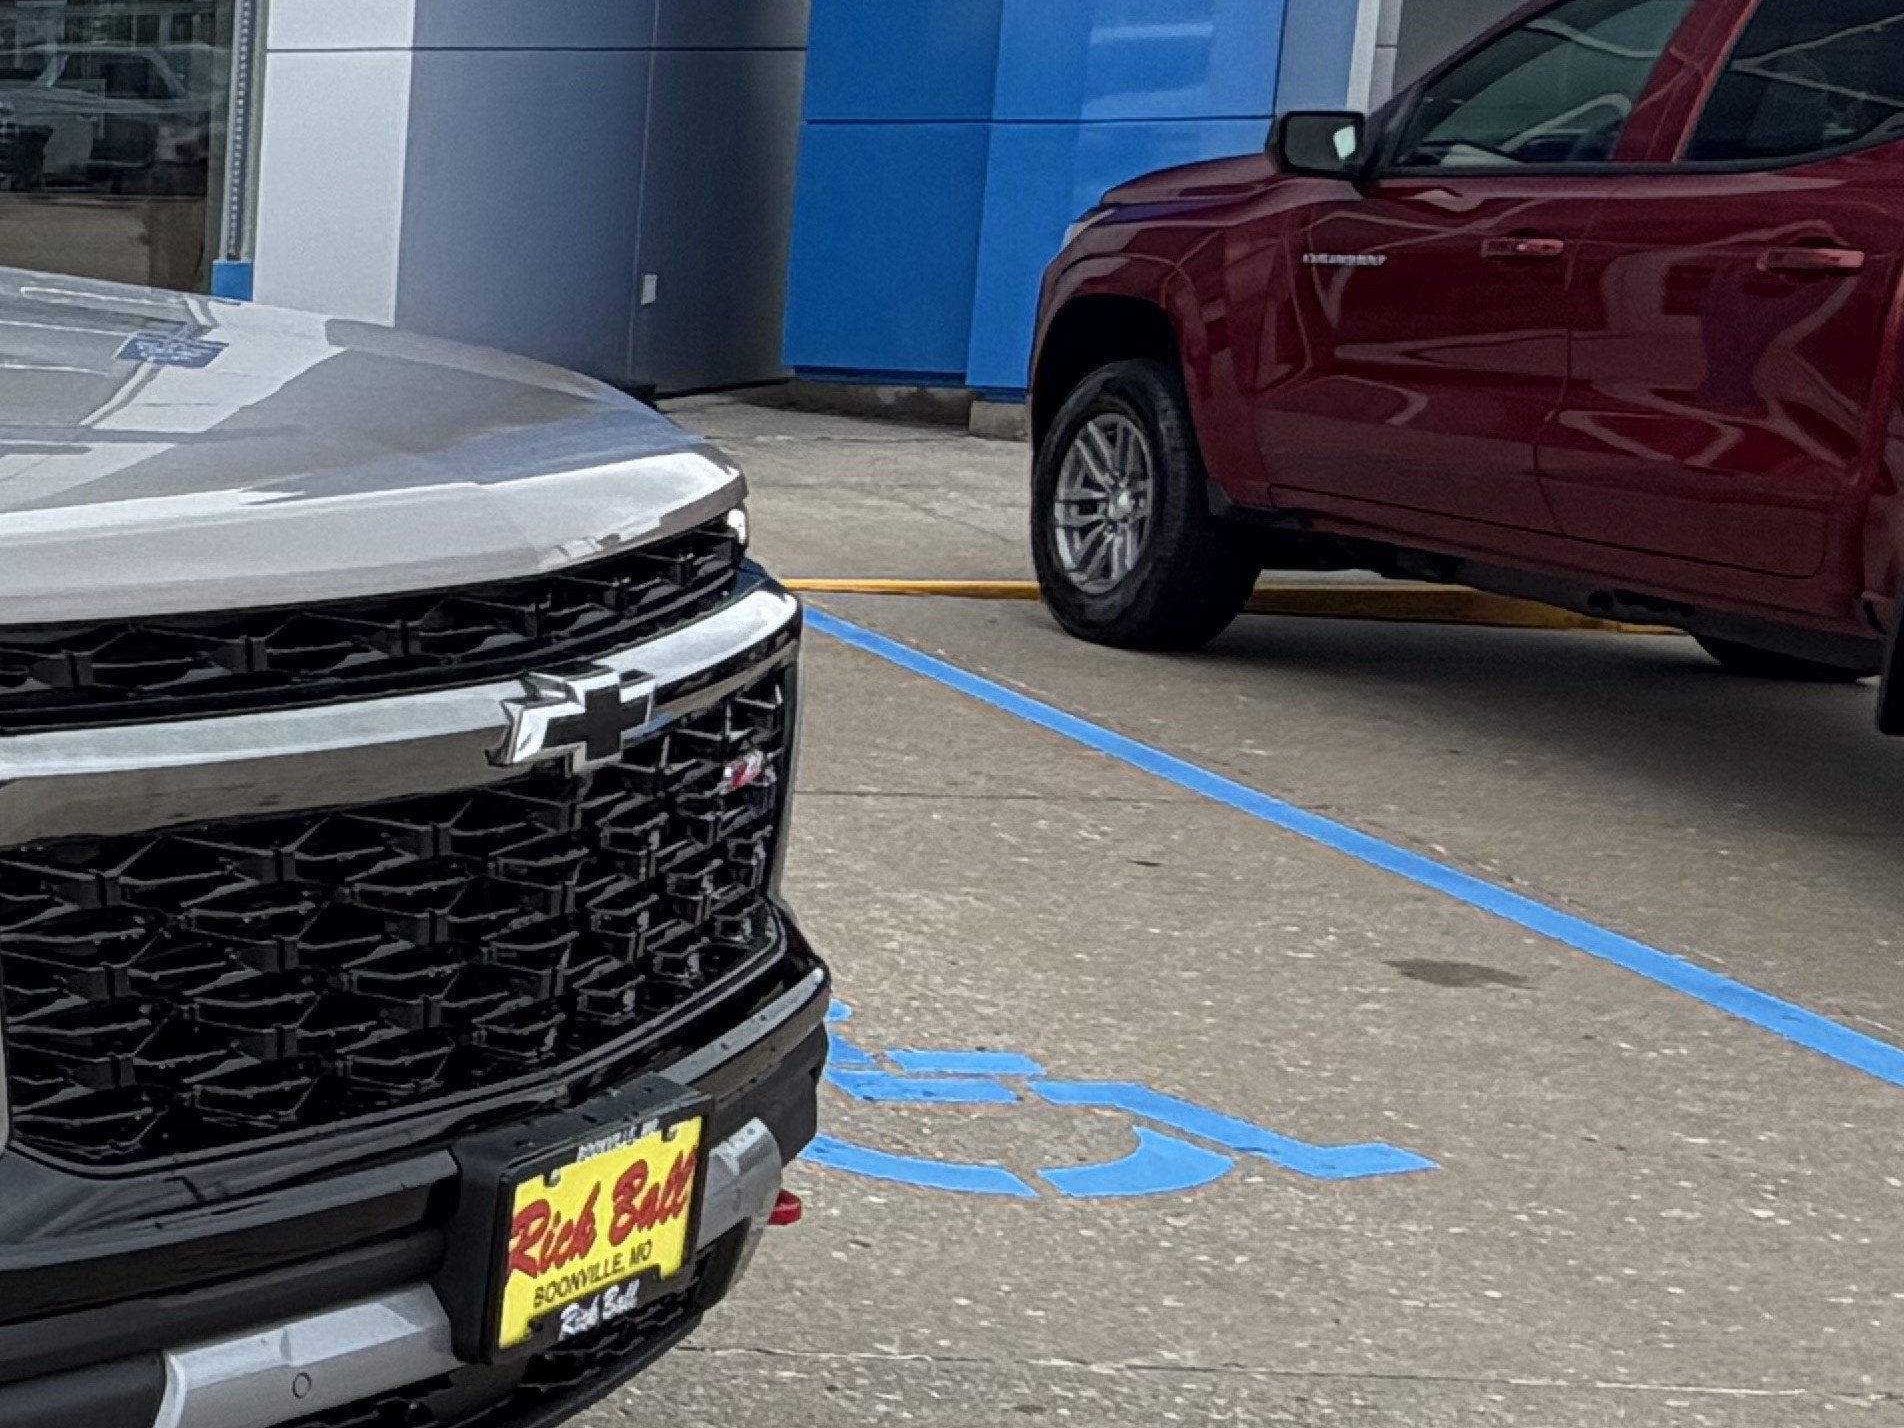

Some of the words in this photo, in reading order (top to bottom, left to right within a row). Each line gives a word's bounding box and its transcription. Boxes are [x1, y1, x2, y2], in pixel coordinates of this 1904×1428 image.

[508, 1180, 602, 1279] Rick
[608, 1145, 698, 1248] Ball
[630, 1239, 653, 1268] MO
